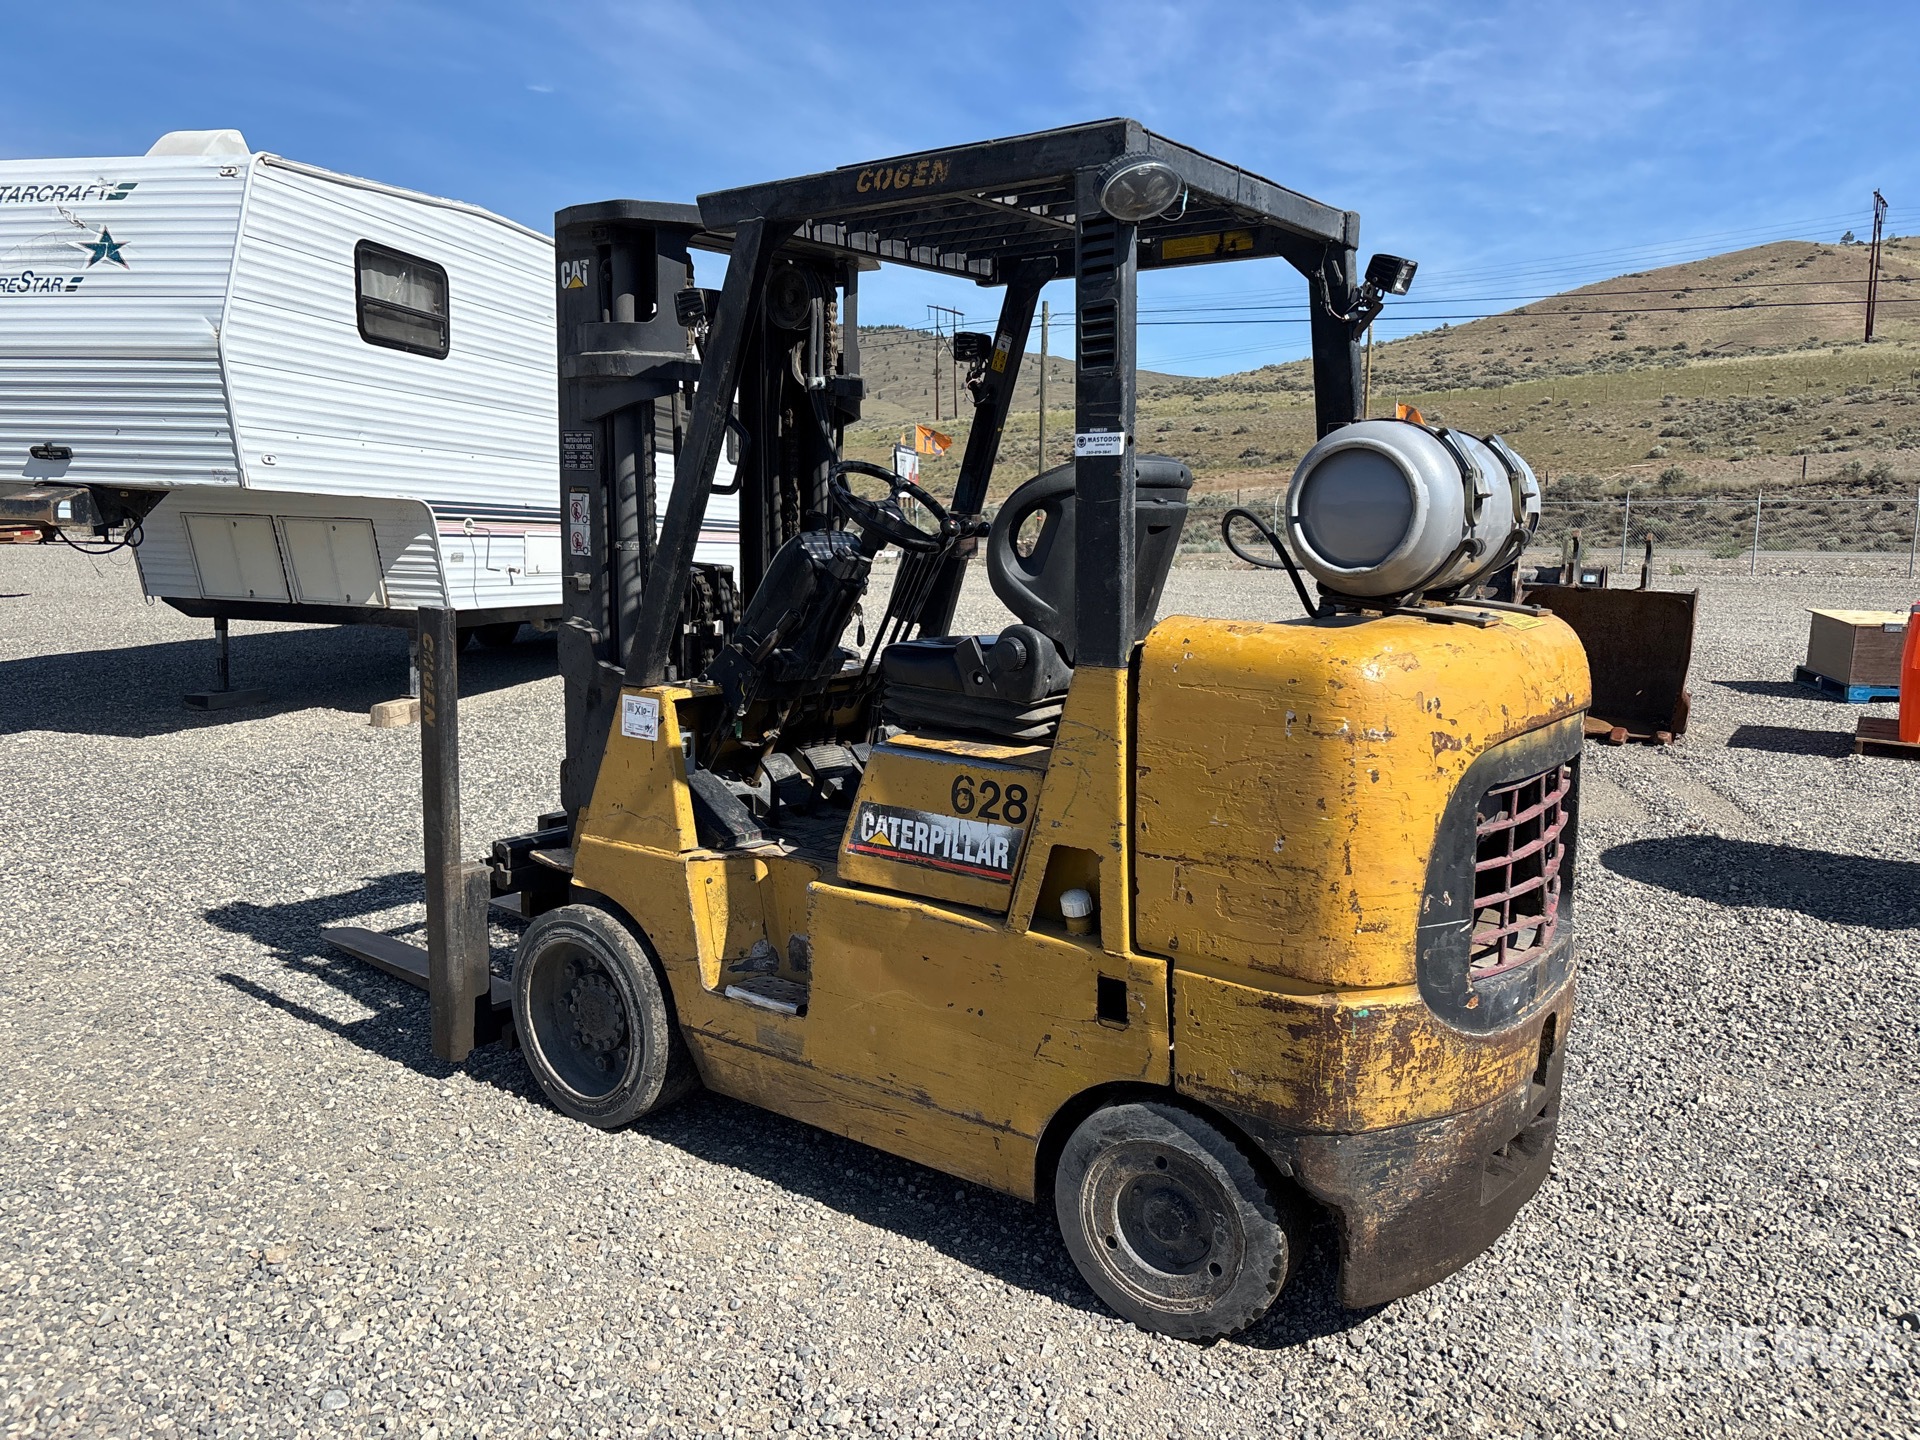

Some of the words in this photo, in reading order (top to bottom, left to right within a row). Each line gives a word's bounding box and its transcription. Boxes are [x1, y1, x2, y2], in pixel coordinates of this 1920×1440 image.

[856, 158, 952, 193] COGEN
[560, 259, 590, 289] CAT
[422, 633, 436, 728] COGEN
[951, 774, 1028, 825] 628
[860, 810, 1010, 870] CATERPILLAR
